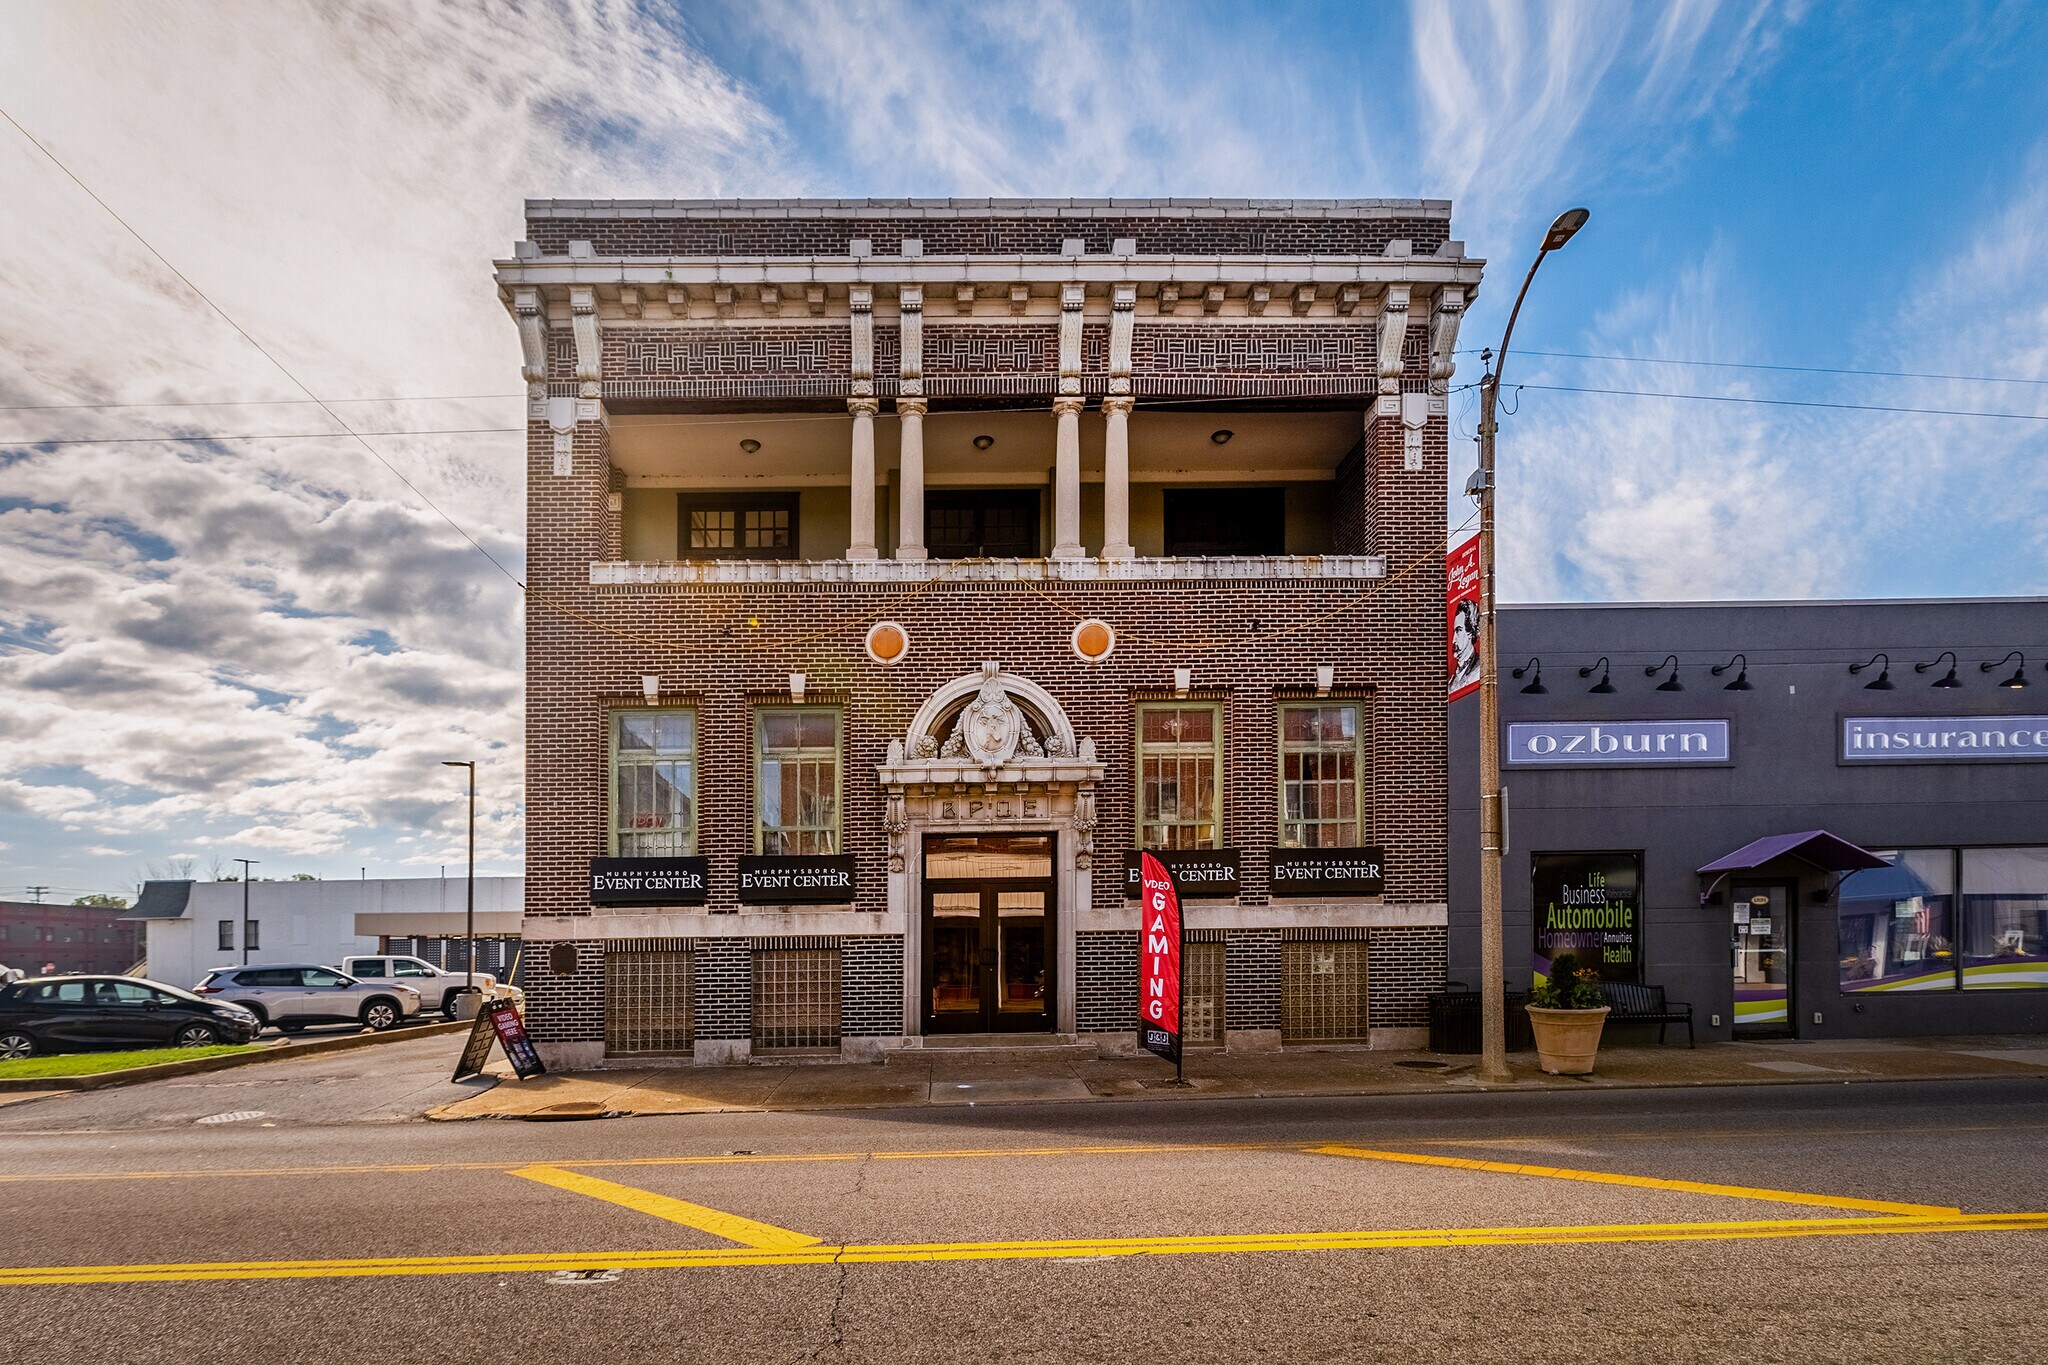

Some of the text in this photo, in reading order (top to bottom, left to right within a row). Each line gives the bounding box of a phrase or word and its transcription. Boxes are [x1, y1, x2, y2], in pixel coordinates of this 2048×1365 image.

[1447, 564, 1464, 591] John
[1457, 569, 1479, 590] Logan
[1527, 727, 1708, 754] ozburn
[1853, 726, 2048, 750] insurance
[741, 872, 851, 888] EVENT CENTER
[1179, 866, 1236, 882] CENTER
[1274, 864, 1381, 880] EVENT CENTER
[1588, 871, 1605, 888] Life
[593, 874, 703, 890] EVENT CENTER
[1562, 884, 1606, 905] Business
[1546, 900, 1633, 929] Automobile
[1538, 927, 1604, 949] Homeowner
[1603, 931, 1633, 943] Annuities
[1148, 892, 1169, 1020] GAMING
[1603, 944, 1632, 963] Health
[497, 1013, 513, 1022] VIDEO
[497, 1019, 519, 1030] GAMING
[504, 1027, 518, 1036] HERE
